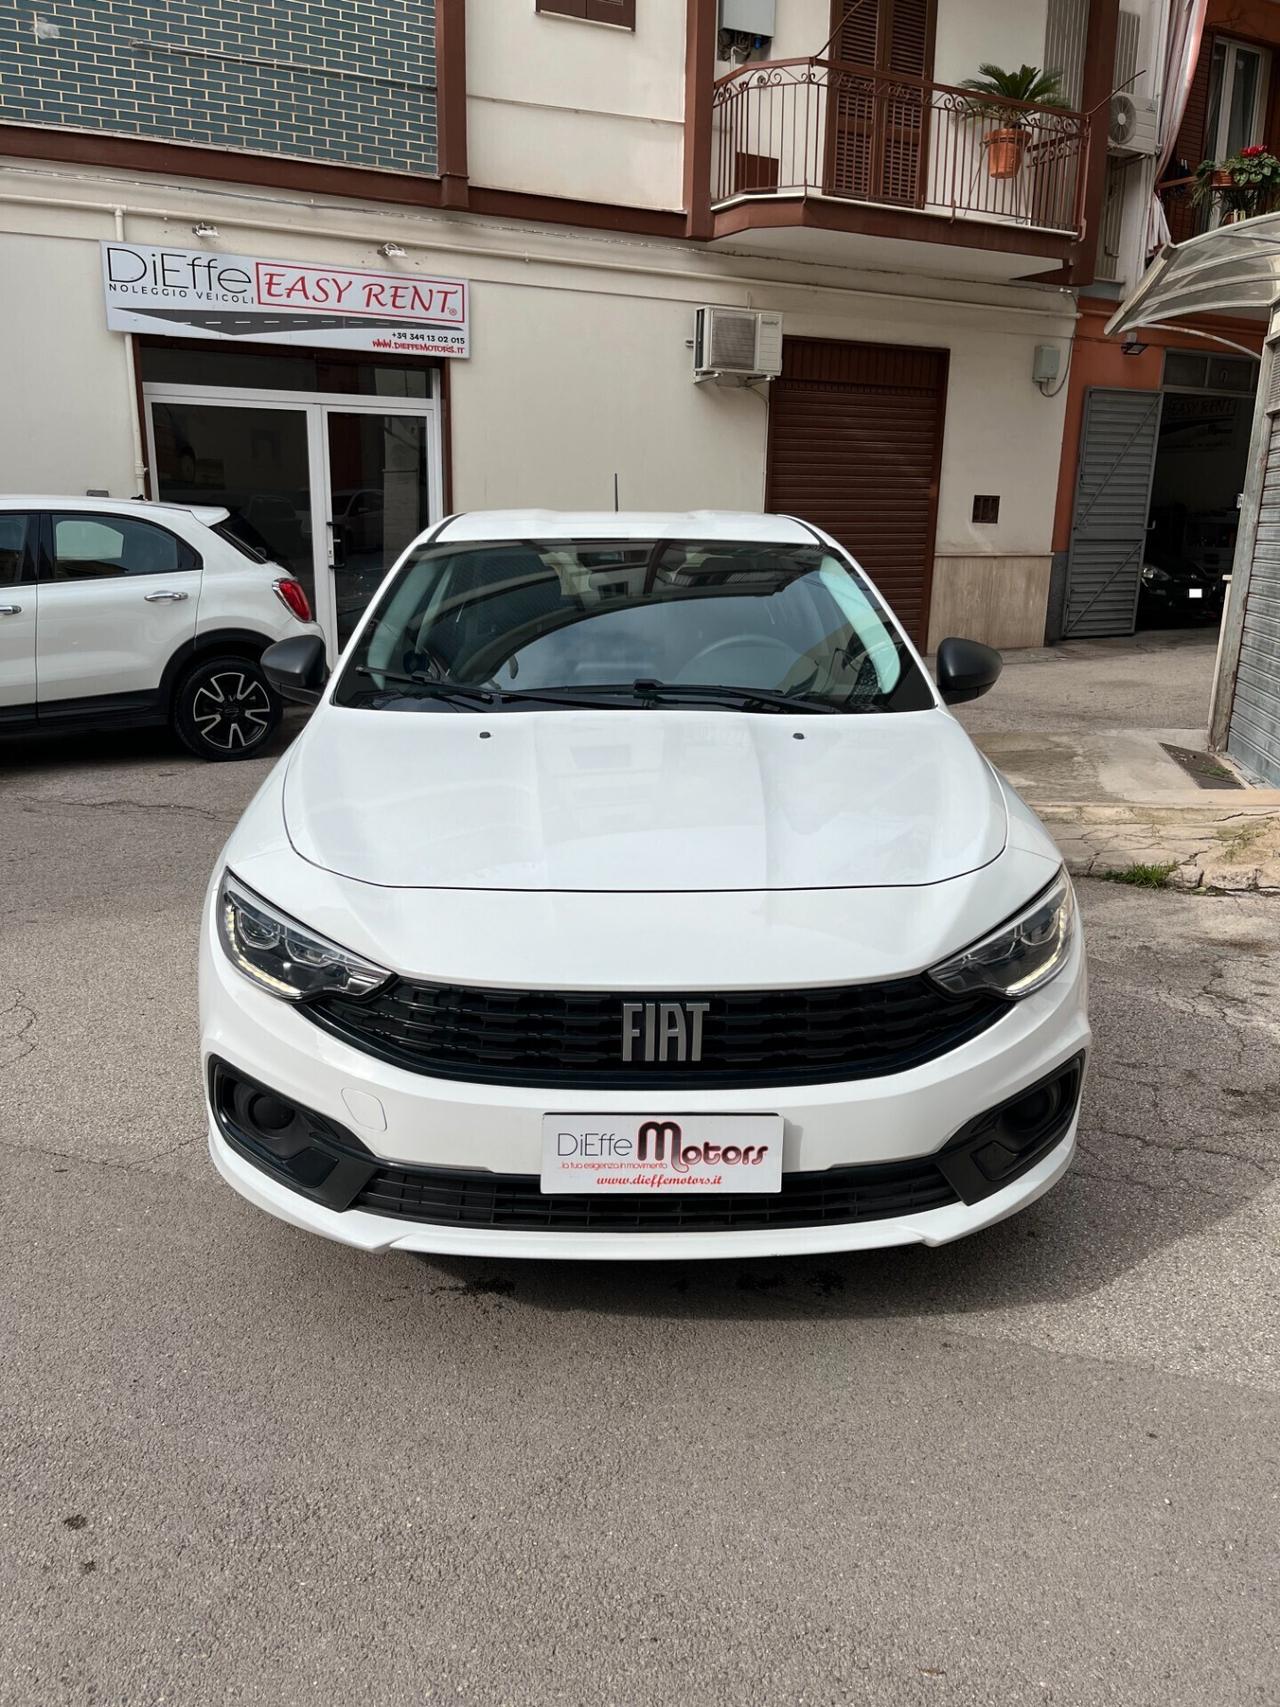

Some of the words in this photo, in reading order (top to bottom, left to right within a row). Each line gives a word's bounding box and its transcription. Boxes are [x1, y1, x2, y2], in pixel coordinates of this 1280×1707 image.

[107, 247, 252, 294] DiEffe
[109, 283, 188, 298] NOLEGGIO
[196, 291, 254, 304] VEICOLI
[264, 272, 353, 303] EASY
[392, 332, 407, 340] +39
[409, 333, 425, 341] 349
[622, 1003, 710, 1062] FIAT
[557, 1133, 633, 1157] DiEffe
[637, 1121, 769, 1174] Motors
[597, 1174, 722, 1188] www.dieffemotors.it
